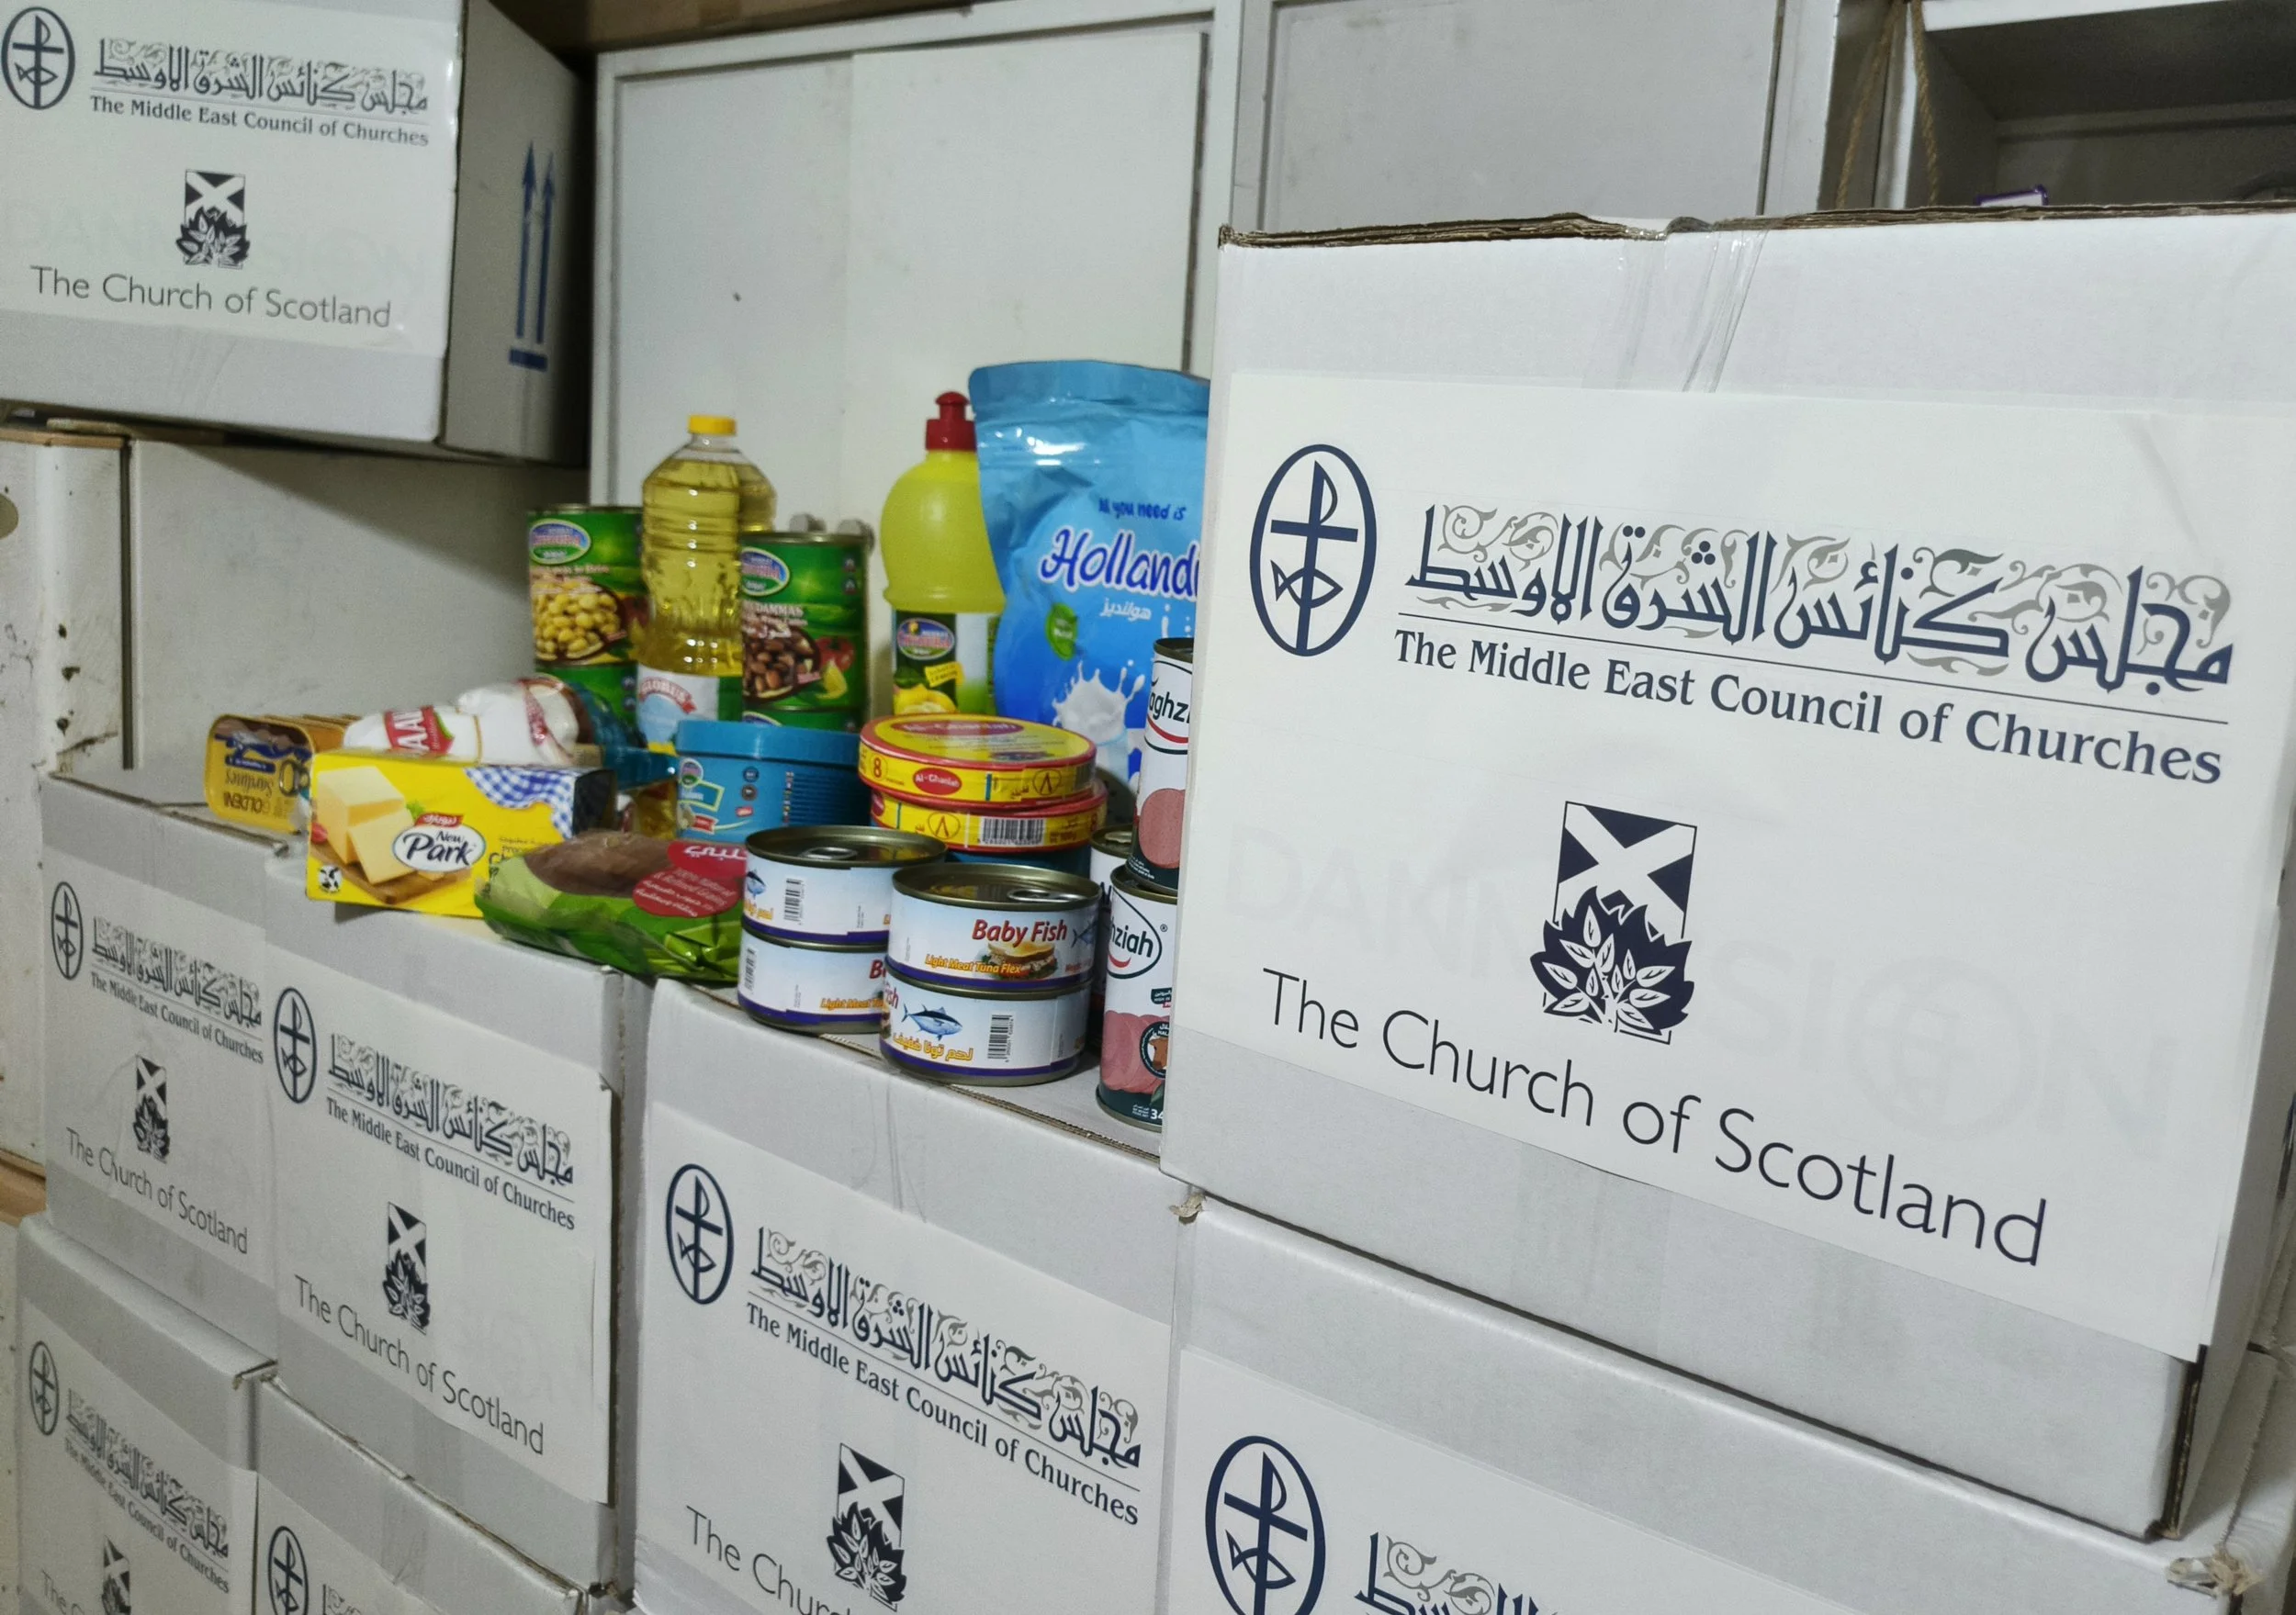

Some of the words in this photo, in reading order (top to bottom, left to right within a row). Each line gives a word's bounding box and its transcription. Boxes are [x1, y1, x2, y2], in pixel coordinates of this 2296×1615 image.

[193, 50, 264, 100] الشرق
[266, 61, 355, 106] كنائس
[361, 69, 428, 114] مجلس
[90, 95, 124, 114] The
[130, 100, 191, 121] Middle
[197, 107, 237, 126] East
[244, 112, 312, 134] Council
[320, 119, 338, 136] of
[343, 121, 429, 146] Churches
[29, 264, 90, 299] The
[102, 273, 213, 311] Church
[225, 286, 258, 315] of
[265, 289, 392, 329] Scotland
[1138, 503, 1170, 520] need
[1173, 507, 1187, 521] is
[1602, 525, 1778, 645] الشرق
[1773, 543, 2009, 665] كنائس
[2025, 566, 2234, 694] مجلس
[1395, 630, 1457, 669] The
[1468, 640, 1590, 690] Middle
[1604, 659, 1694, 705] East
[1710, 674, 1882, 734] Council
[1900, 702, 1954, 743] of
[1966, 710, 2222, 784] Churches
[873, 757, 883, 778] 8
[224, 791, 271, 814] GOLDEN
[403, 832, 473, 866] Park
[436, 831, 462, 842] New
[972, 919, 1028, 947] Baby
[1031, 920, 1068, 942] Fish
[137, 937, 174, 993] الشرق
[174, 959, 220, 1007] كنائس
[925, 954, 948, 967] Light
[949, 958, 974, 971] Meat
[975, 963, 999, 973] Tuna
[1000, 964, 1022, 974] Flex
[91, 971, 107, 992] The
[109, 979, 137, 1006] Middle
[139, 994, 158, 1018] East
[161, 1005, 199, 1035] Council
[202, 1025, 212, 1040] of
[215, 1027, 264, 1065] Churches
[224, 978, 262, 1028] مجلس
[820, 998, 846, 1010] Light
[923, 1041, 944, 1058] تونا
[945, 1048, 974, 1061] لحم
[391, 1062, 441, 1132] الشرق
[443, 1095, 513, 1152] كنائس
[1263, 968, 1358, 1049] The
[1382, 1010, 1593, 1127] Church
[1623, 1094, 1701, 1153] of
[1716, 1107, 2046, 1266] Scotland
[326, 1097, 348, 1124] The
[352, 1110, 392, 1145] Middle
[395, 1129, 421, 1161] East
[424, 1148, 480, 1187] Council
[485, 1176, 500, 1195] of
[503, 1182, 575, 1230] Churches
[517, 1124, 574, 1185] مجلس
[66, 1127, 94, 1166] The
[99, 1148, 152, 1200] Church
[158, 1184, 174, 1211] of
[179, 1191, 247, 1254] Scotland
[852, 1278, 933, 1372] الشرق
[295, 1274, 331, 1323] The
[338, 1305, 410, 1374] Church
[416, 1363, 436, 1392] of
[443, 1370, 543, 1454] Scotland
[934, 1332, 1042, 1421] كنائس
[747, 1302, 781, 1340] The
[786, 1315, 850, 1374] Middle
[855, 1358, 900, 1402] East
[906, 1380, 988, 1447] Council
[995, 1432, 1019, 1464] of
[1024, 1448, 1139, 1526] Churches
[1049, 1385, 1142, 1470] مجلس
[108, 1482, 126, 1510] East
[128, 1501, 164, 1543] Council
[166, 1535, 178, 1553] of
[180, 1543, 230, 1593] Churches
[687, 1505, 740, 1571] The
[753, 1553, 850, 1615] Chur
